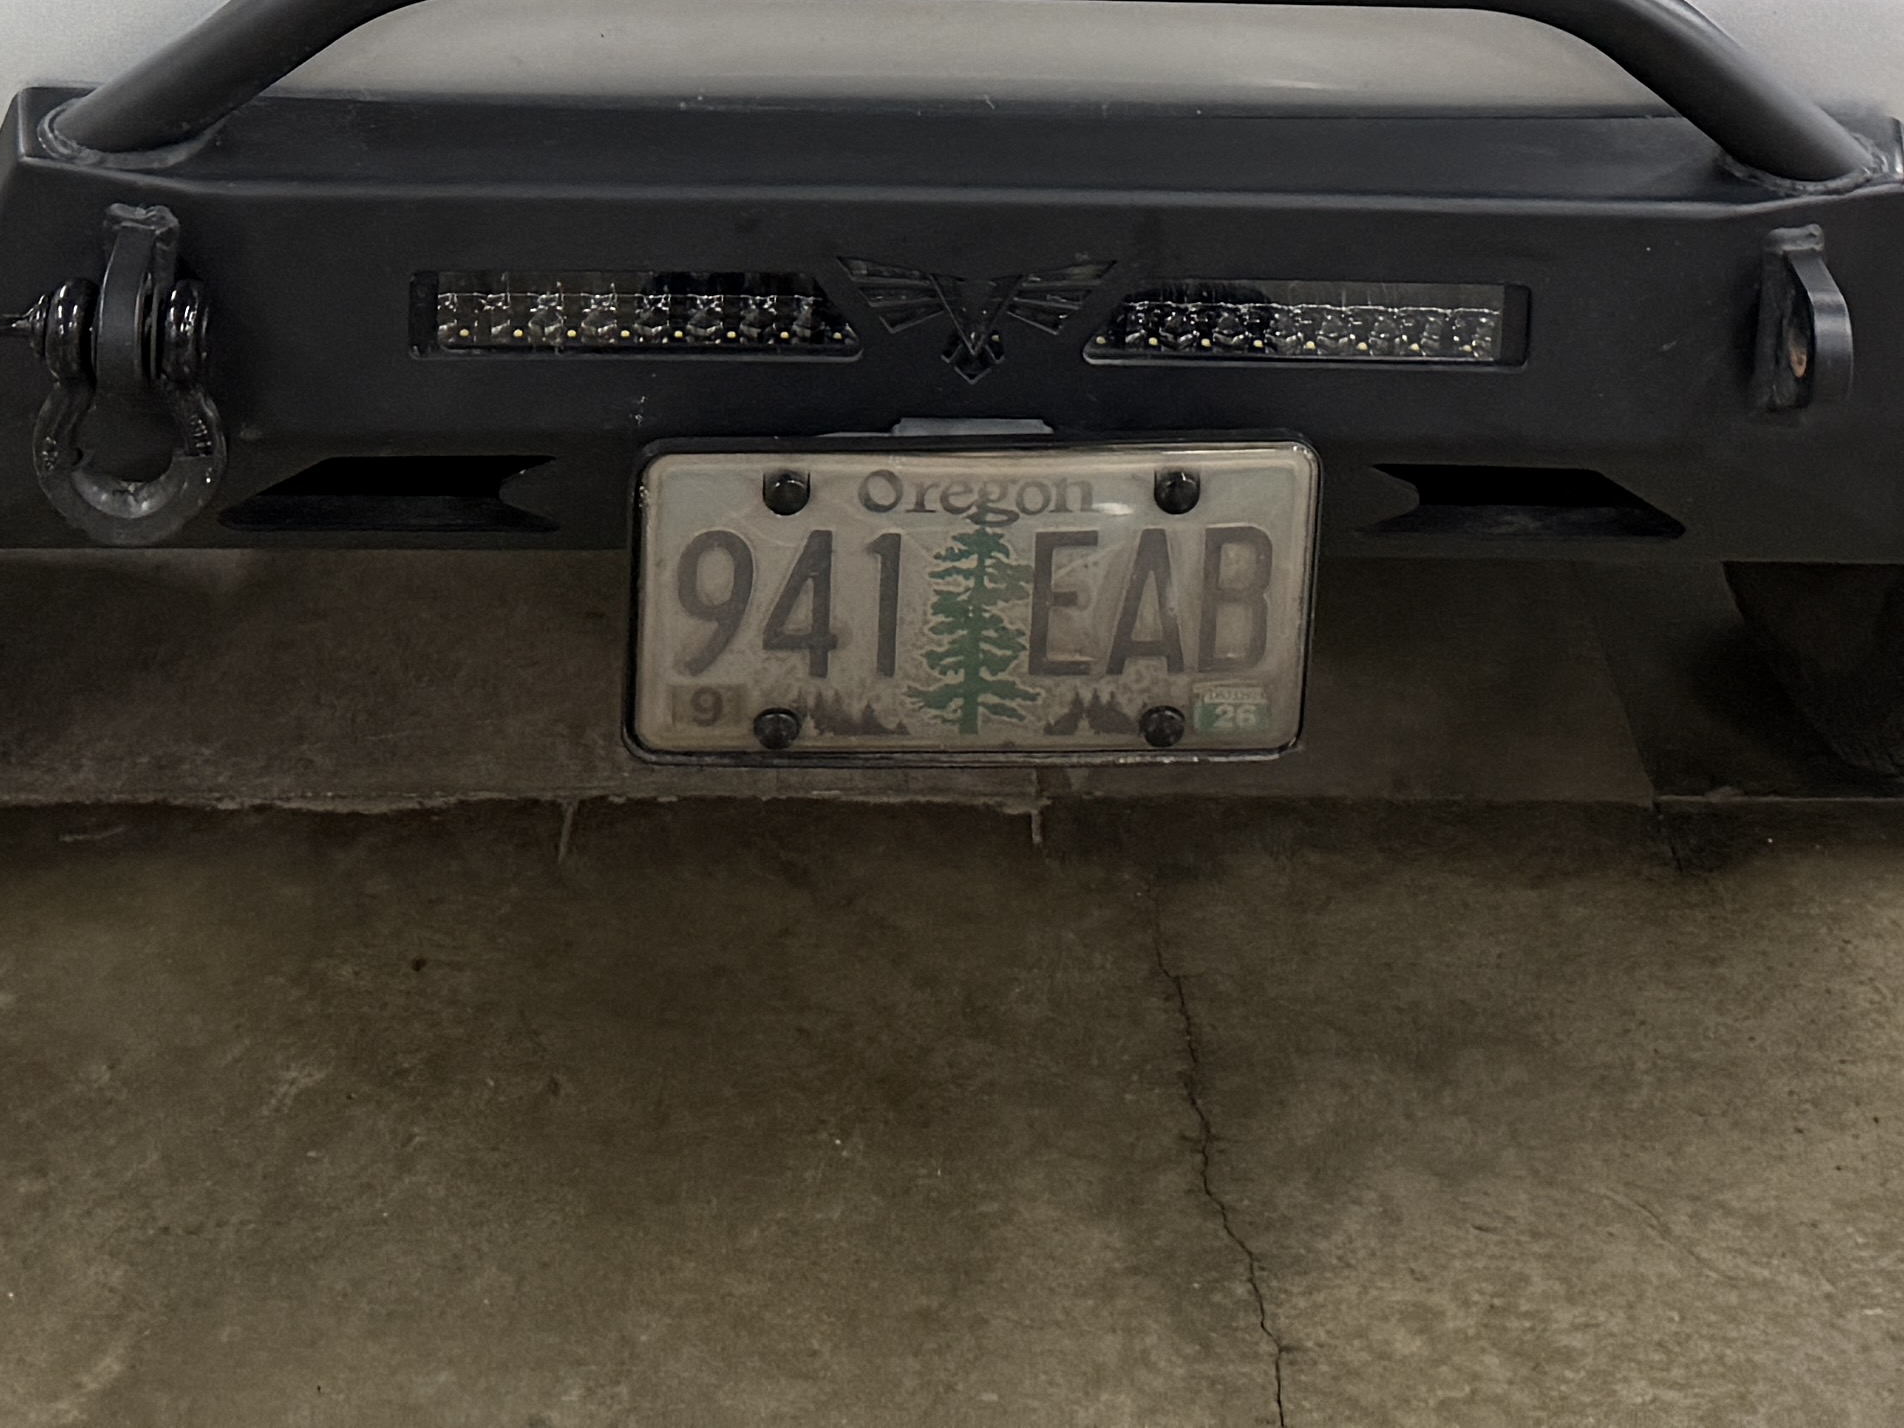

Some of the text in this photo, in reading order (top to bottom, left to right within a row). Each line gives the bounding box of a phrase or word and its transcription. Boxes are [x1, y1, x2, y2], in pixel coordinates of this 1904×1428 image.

[858, 469, 1095, 527] Oregon
[676, 525, 1276, 678] 941 EAB
[690, 686, 723, 727] 9
[1213, 704, 1257, 729] 26
